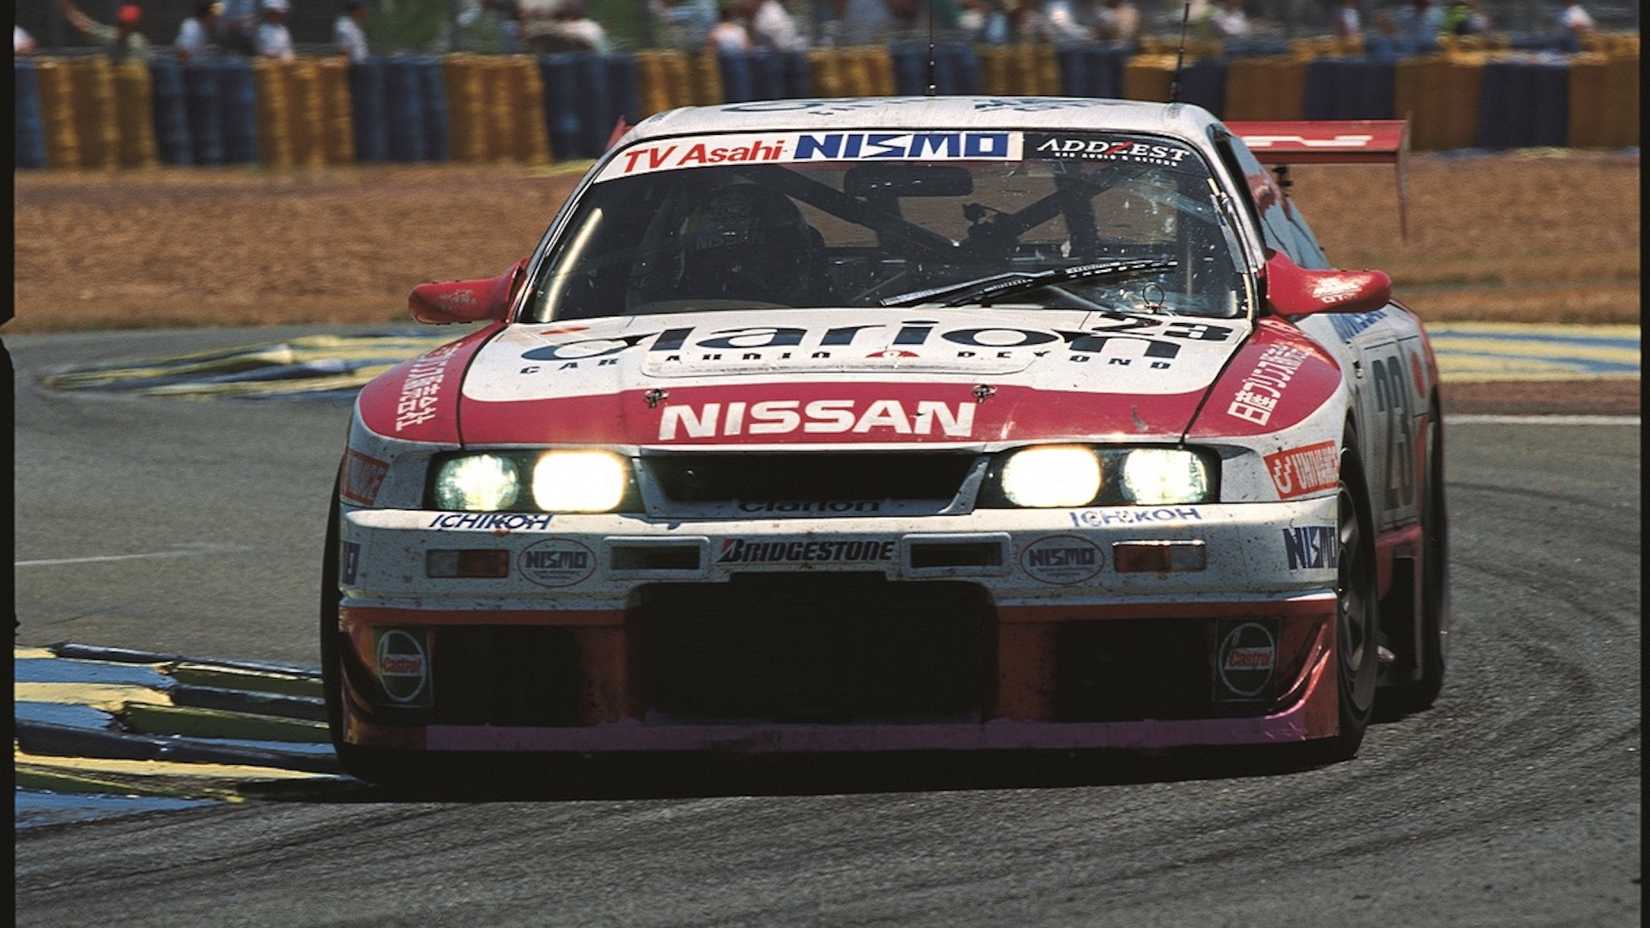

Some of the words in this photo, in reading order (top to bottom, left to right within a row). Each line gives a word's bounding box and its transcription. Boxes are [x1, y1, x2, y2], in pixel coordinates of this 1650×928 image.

[624, 146, 677, 173] TV
[676, 140, 785, 166] Asahi
[793, 132, 1008, 160] NISMO
[1037, 138, 1190, 161] ADDZEST
[1090, 312, 1236, 342] 23
[658, 399, 977, 441] NISSAN
[430, 512, 554, 530] ICHIKOH
[525, 550, 588, 569] NISMO
[717, 536, 895, 562] BRIDGESTONE
[1029, 549, 1095, 567] NISMO
